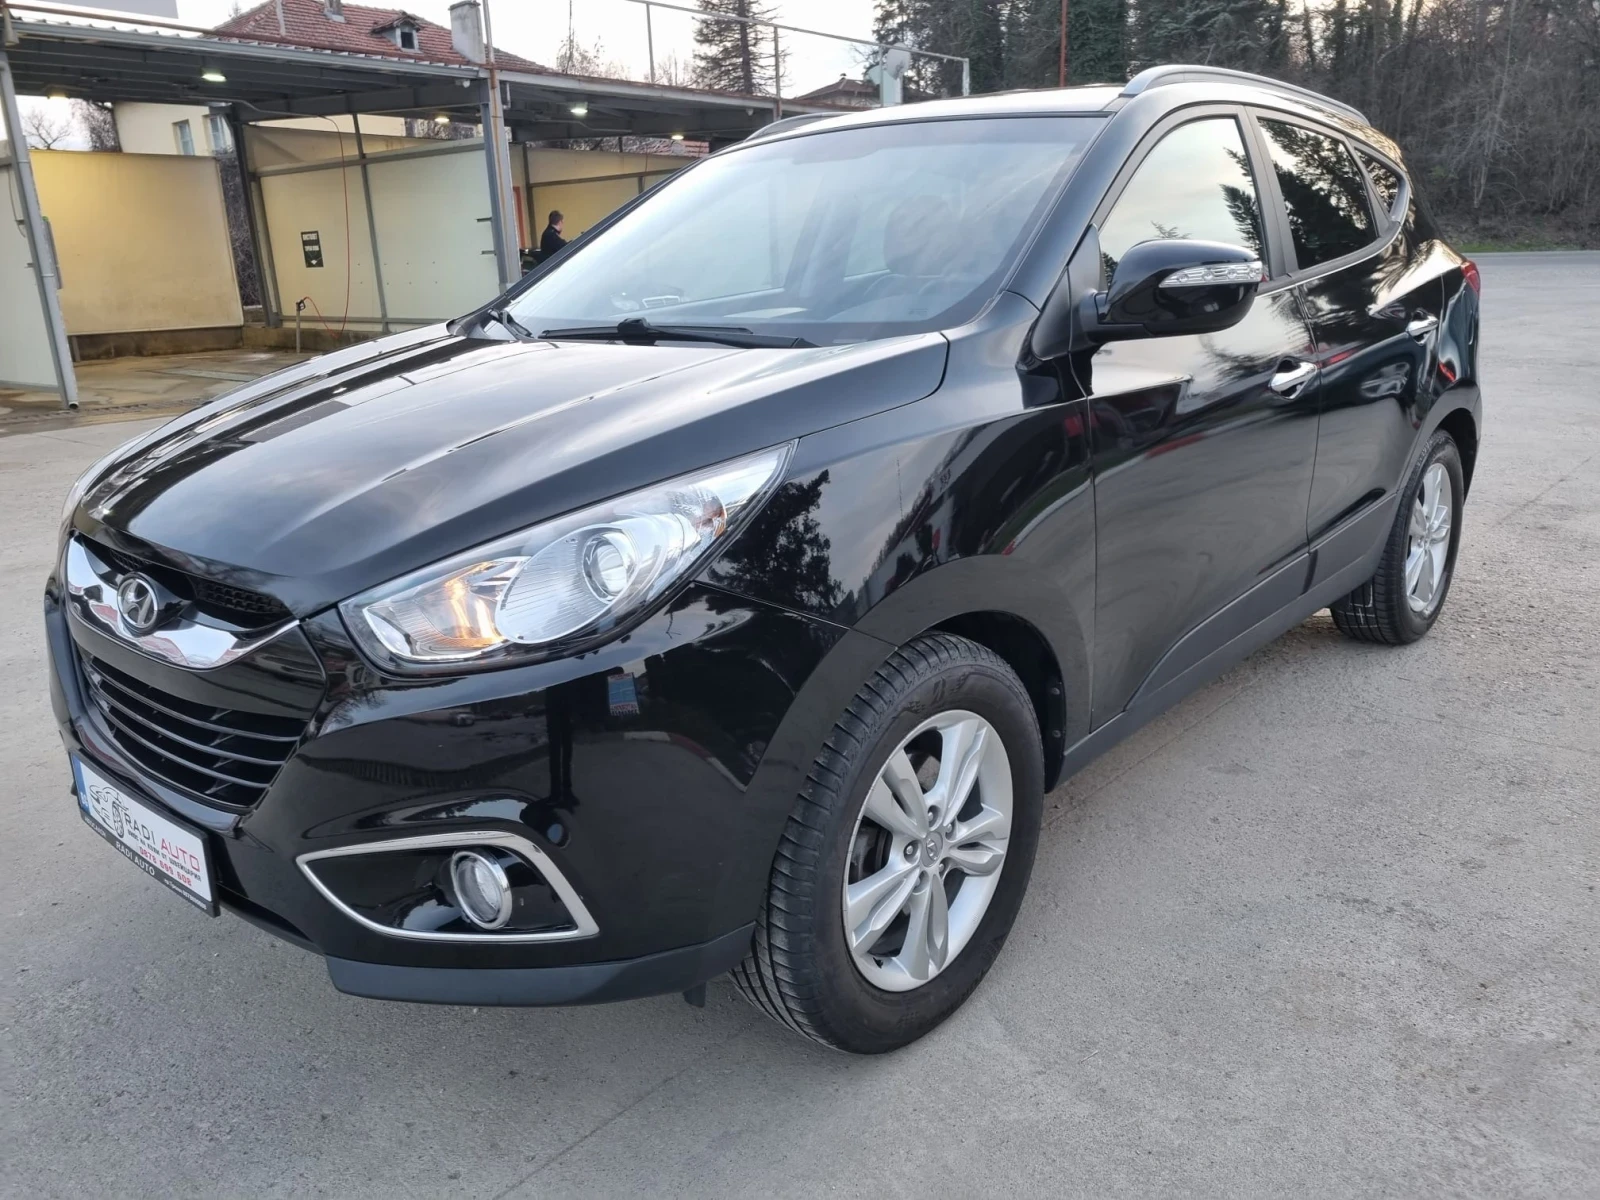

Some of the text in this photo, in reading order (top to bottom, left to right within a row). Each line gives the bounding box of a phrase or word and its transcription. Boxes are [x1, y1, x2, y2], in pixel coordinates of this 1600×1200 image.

[115, 841, 155, 876] RADI AUTO
[123, 812, 155, 845] RADI
[161, 838, 201, 872] AUTO
